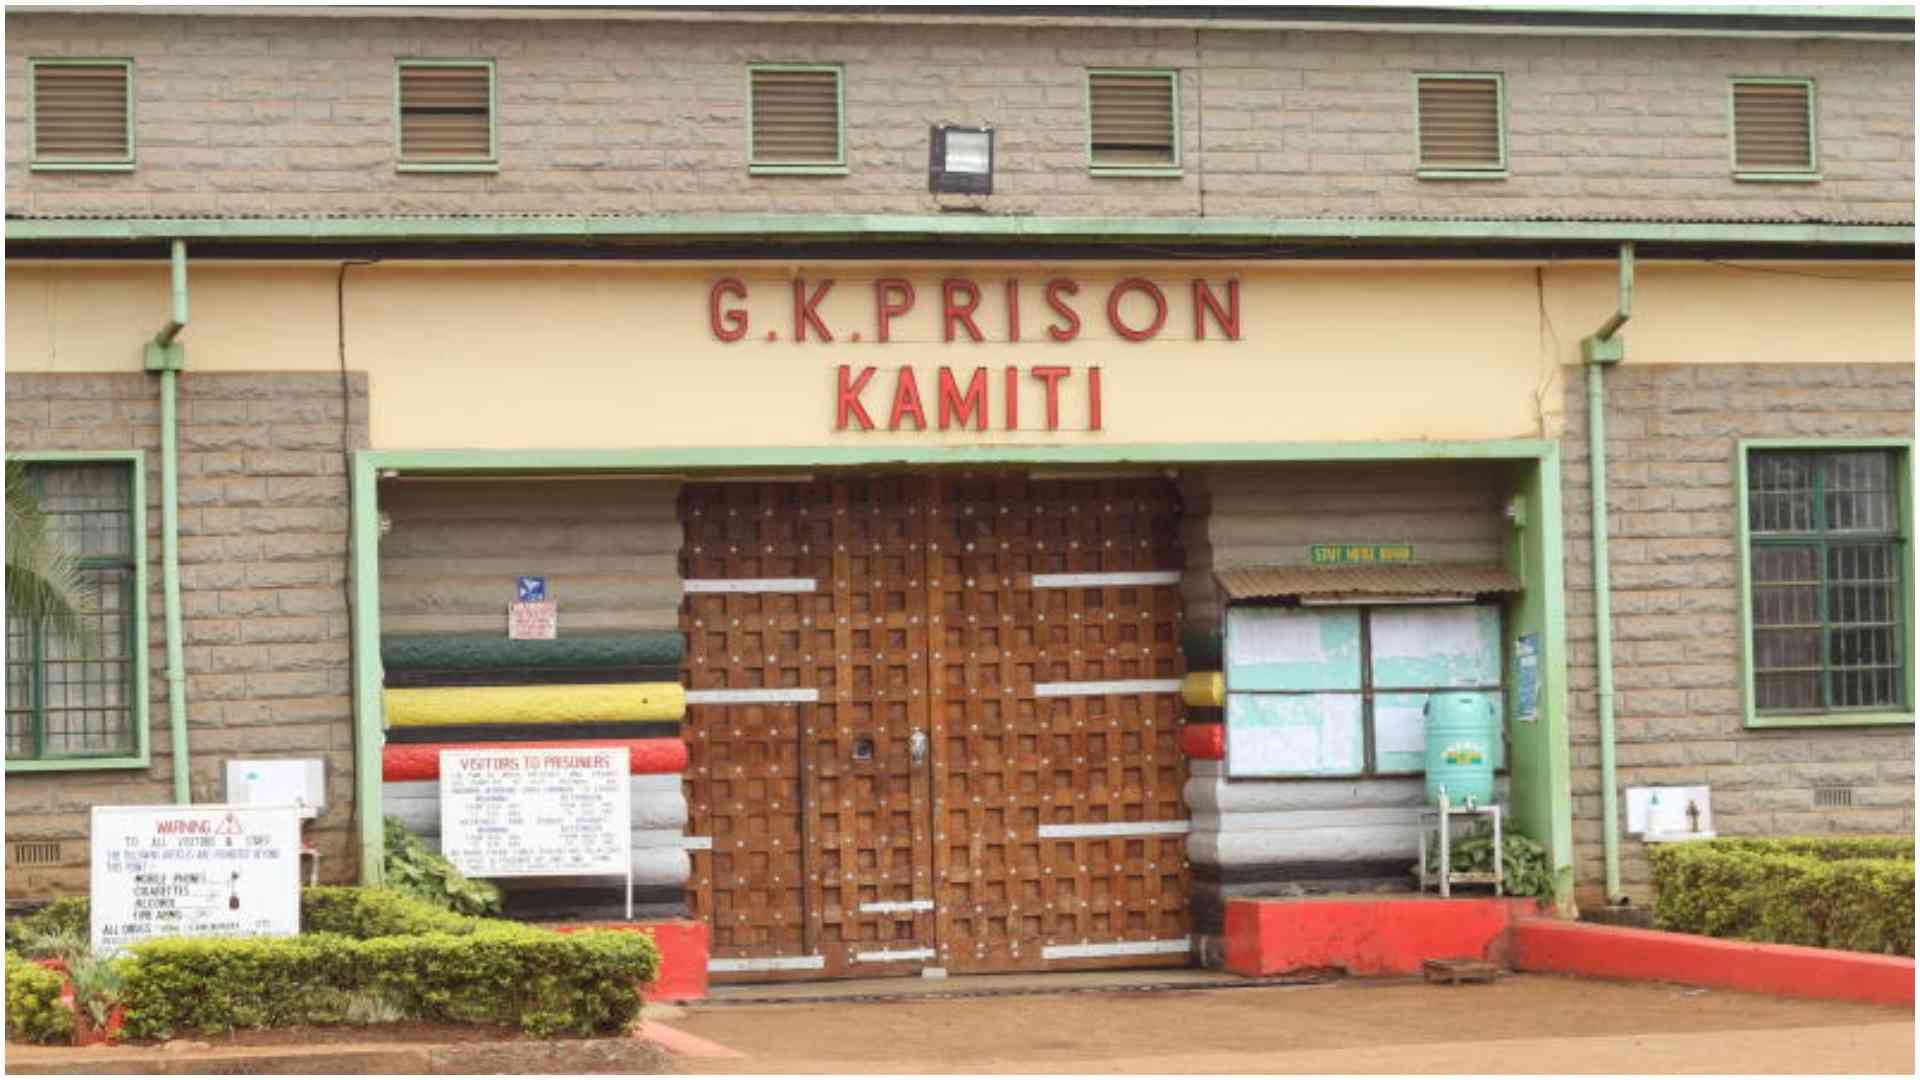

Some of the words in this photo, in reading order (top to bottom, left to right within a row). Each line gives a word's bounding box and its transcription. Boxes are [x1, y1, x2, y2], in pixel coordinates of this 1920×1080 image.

[834, 365, 1103, 432] KAMITI
[461, 757, 520, 771] VISITORS
[525, 756, 540, 769] TO
[544, 756, 610, 769] PRISONERS
[156, 819, 211, 834] WARNING
